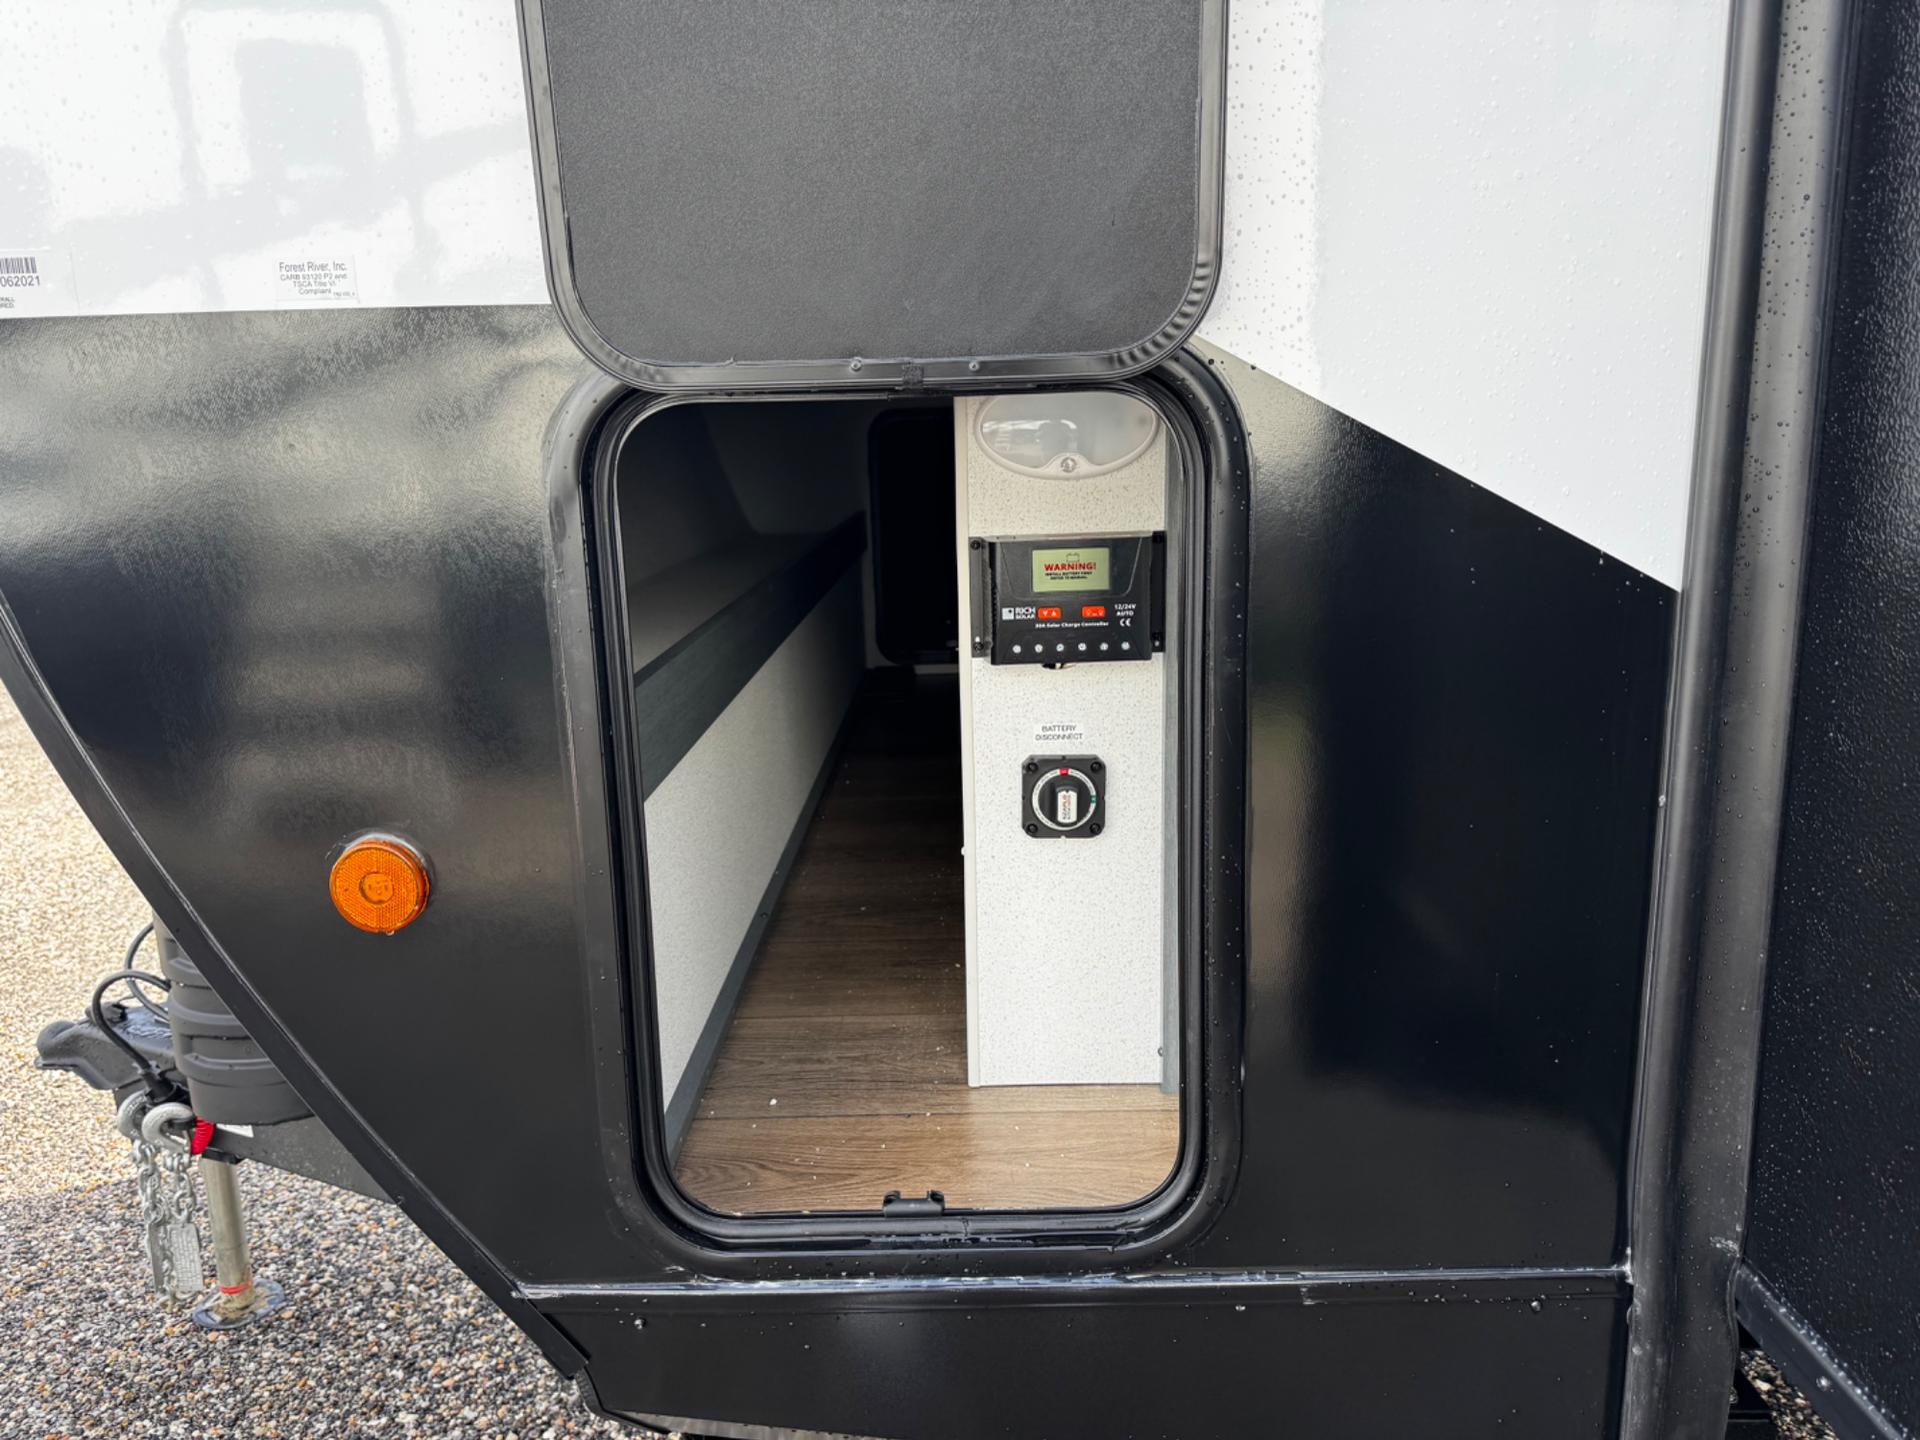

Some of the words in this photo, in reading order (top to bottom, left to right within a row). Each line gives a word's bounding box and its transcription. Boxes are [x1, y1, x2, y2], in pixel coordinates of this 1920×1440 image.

[279, 261, 305, 272] Forest
[307, 261, 331, 272] River,
[333, 261, 348, 271] Inc.
[1044, 562, 1097, 571] WARNING!
